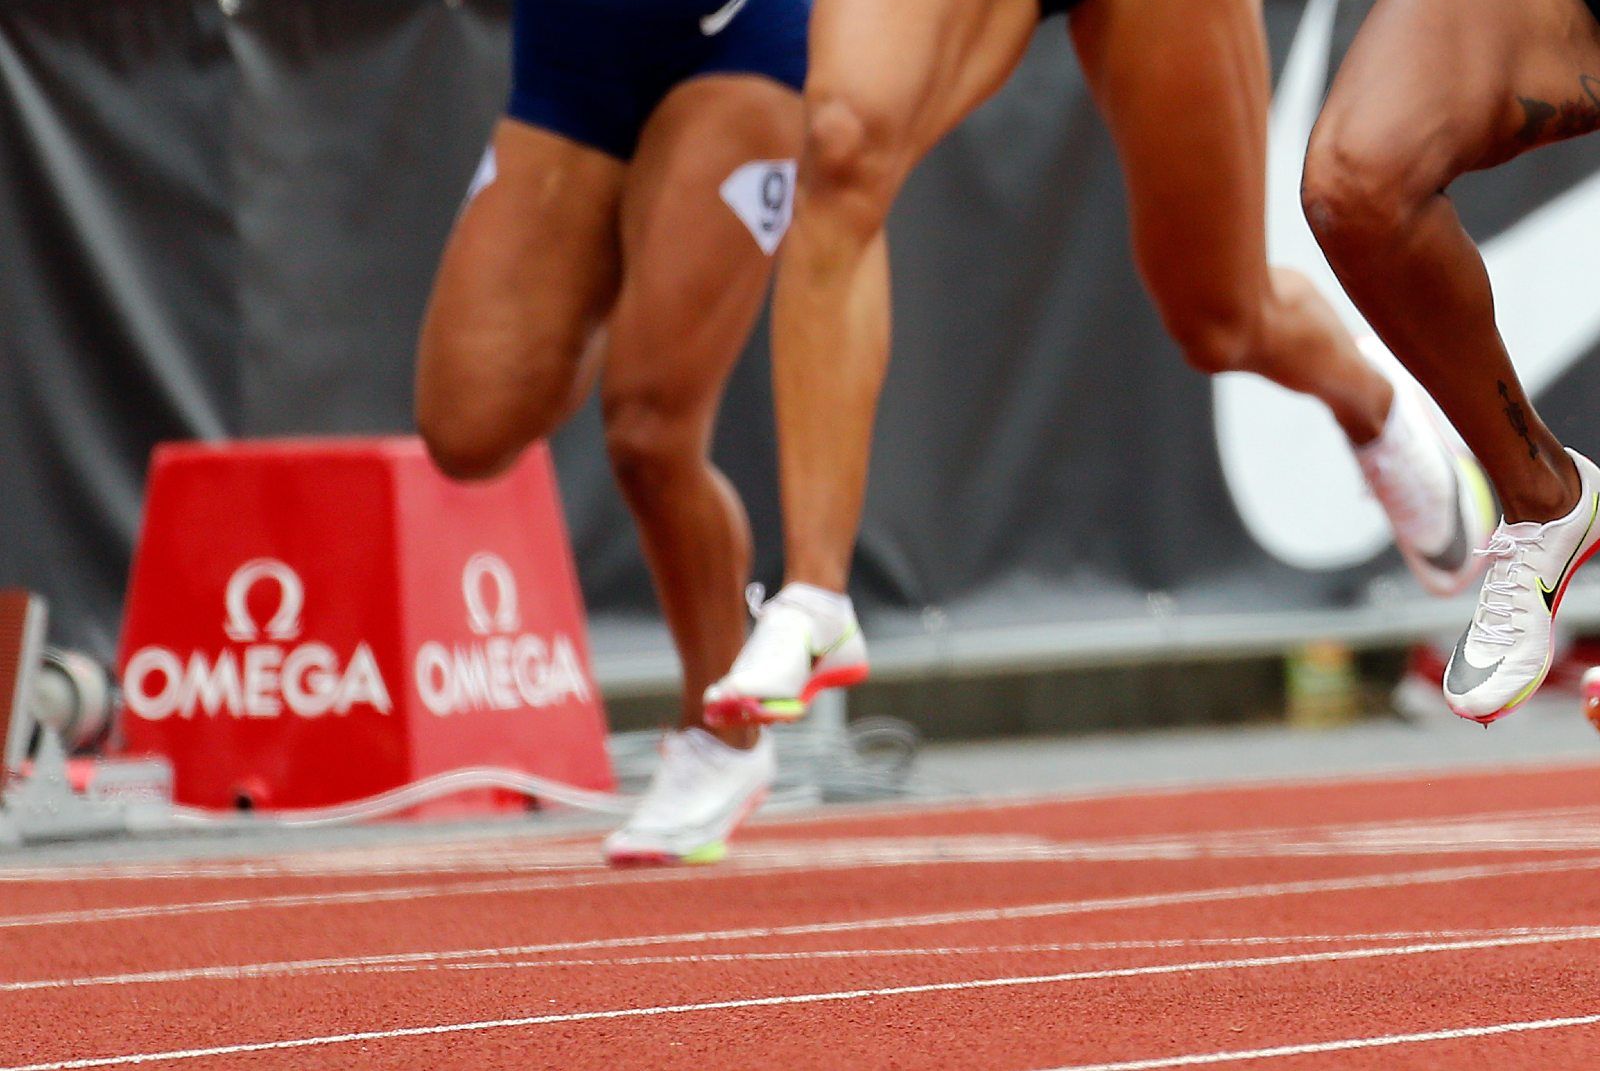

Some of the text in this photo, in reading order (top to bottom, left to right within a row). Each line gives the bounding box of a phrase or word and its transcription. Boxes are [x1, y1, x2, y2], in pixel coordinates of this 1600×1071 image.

[759, 169, 787, 232] 9
[123, 640, 393, 721] OMEGA
[415, 634, 591, 717] OMEGA
